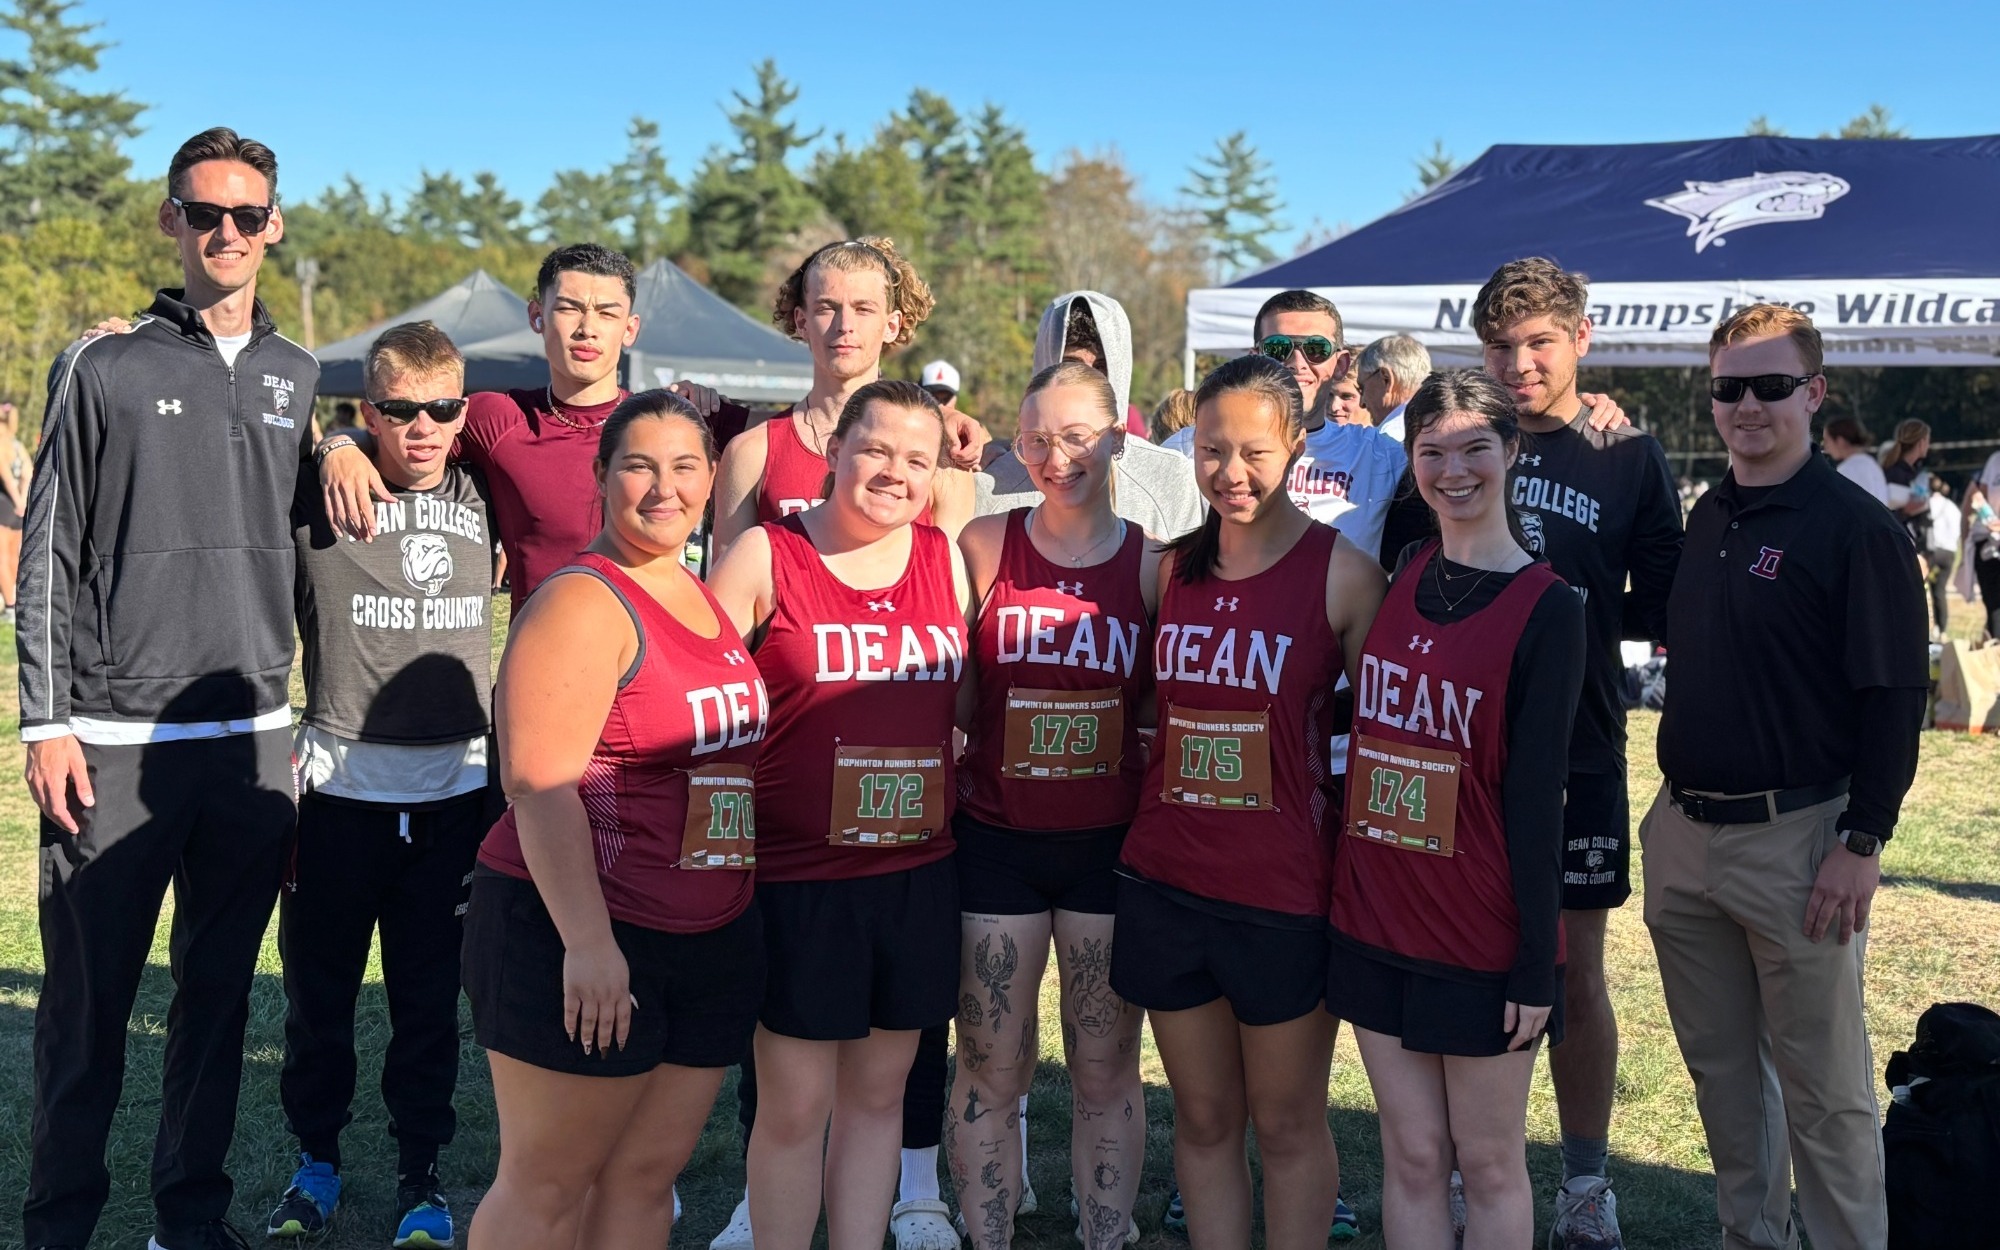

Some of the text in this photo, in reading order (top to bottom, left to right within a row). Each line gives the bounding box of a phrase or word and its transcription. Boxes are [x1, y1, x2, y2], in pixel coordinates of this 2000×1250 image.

[262, 374, 294, 393] DEAN
[415, 499, 483, 545] COLLEGE
[1511, 475, 1600, 534] COLLEGE
[352, 593, 484, 629] CROSS COUNTRY
[812, 623, 963, 682] DEAN
[996, 605, 1140, 679] DEAN
[1155, 623, 1293, 695] DEAN
[1009, 698, 1120, 710] HOPKINTON RUNNERS SOCIETY
[1358, 653, 1483, 749] DEAN
[1029, 714, 1099, 755] 173
[1231, 723, 1265, 732] SOCIETY
[838, 757, 883, 768] HOPKINTON
[884, 759, 917, 768] RUNNERS
[1180, 734, 1242, 782] 175
[1389, 754, 1421, 769] RUNNERS
[1421, 761, 1456, 774] SOCIETY
[707, 791, 756, 840] 170
[857, 773, 924, 819] 172
[1367, 766, 1427, 823] 174
[1568, 836, 1620, 852] DEAN COLLEGE
[1564, 871, 1588, 885] CROSS
